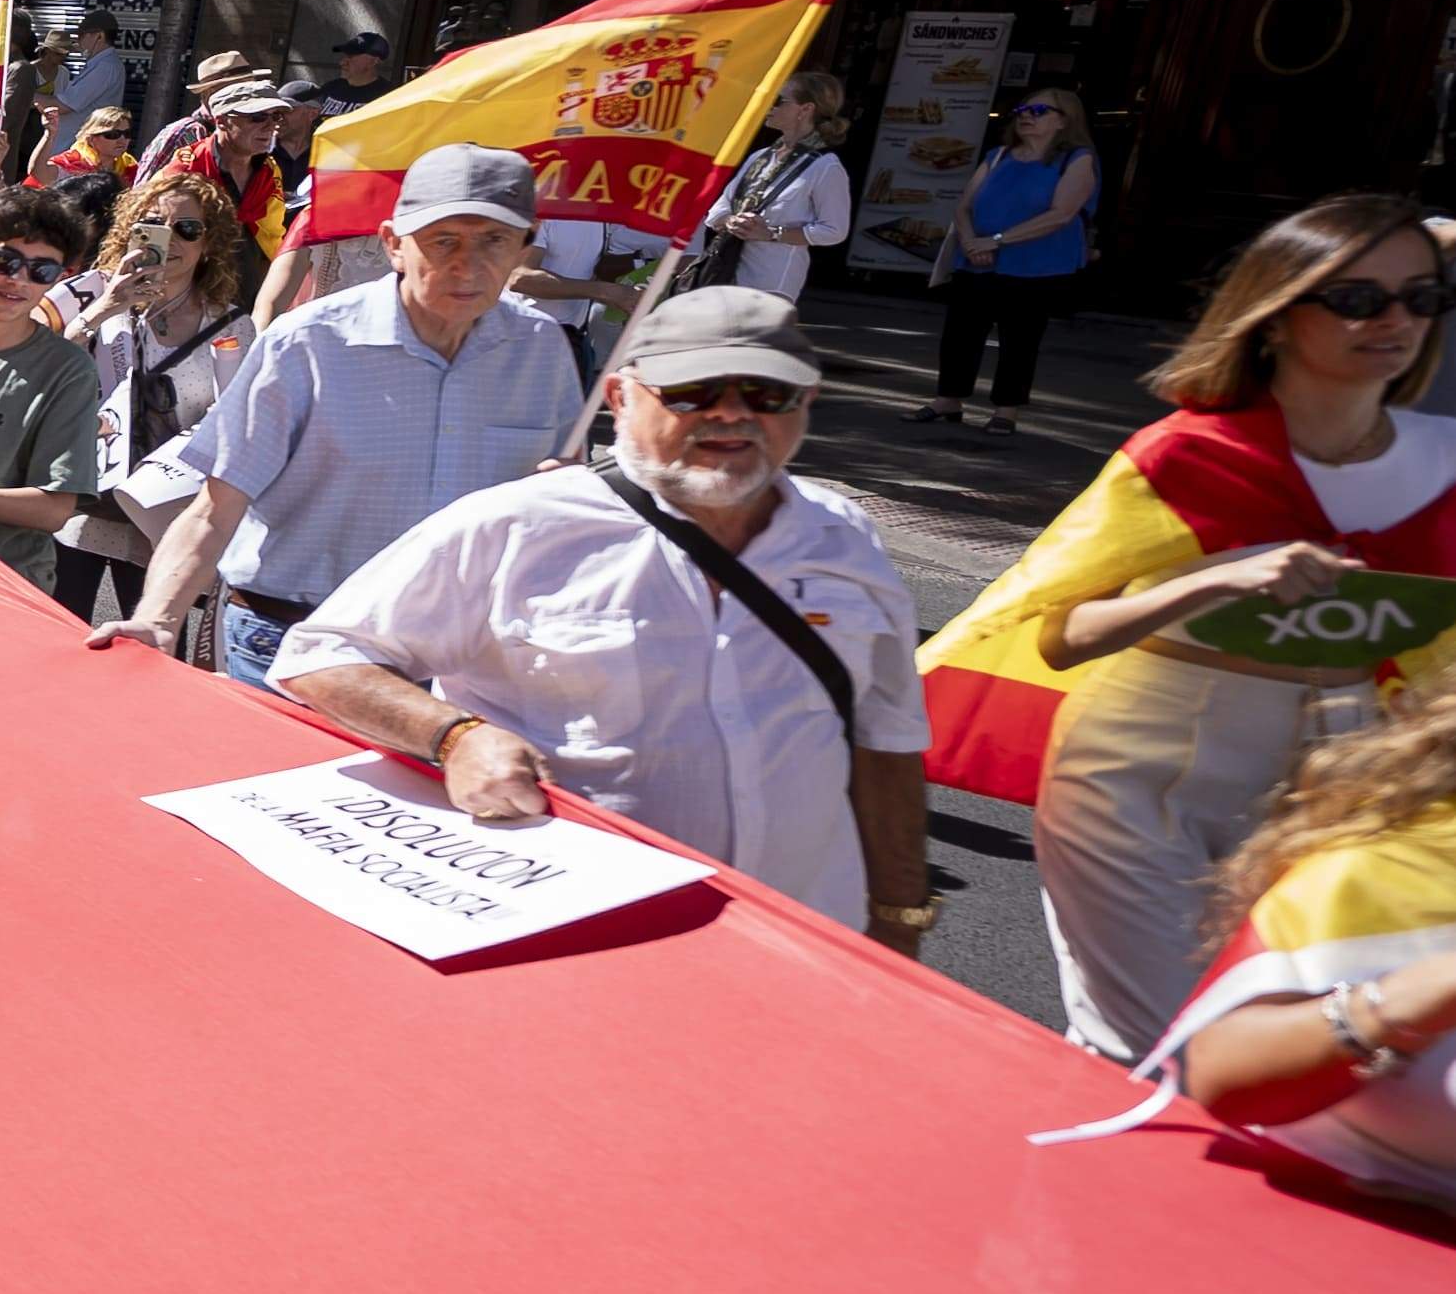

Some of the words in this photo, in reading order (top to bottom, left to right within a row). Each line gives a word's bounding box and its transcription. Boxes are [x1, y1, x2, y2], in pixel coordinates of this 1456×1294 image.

[62, 273, 95, 314] LA
[1255, 598, 1416, 646] VOX
[277, 811, 365, 855] MAFIA
